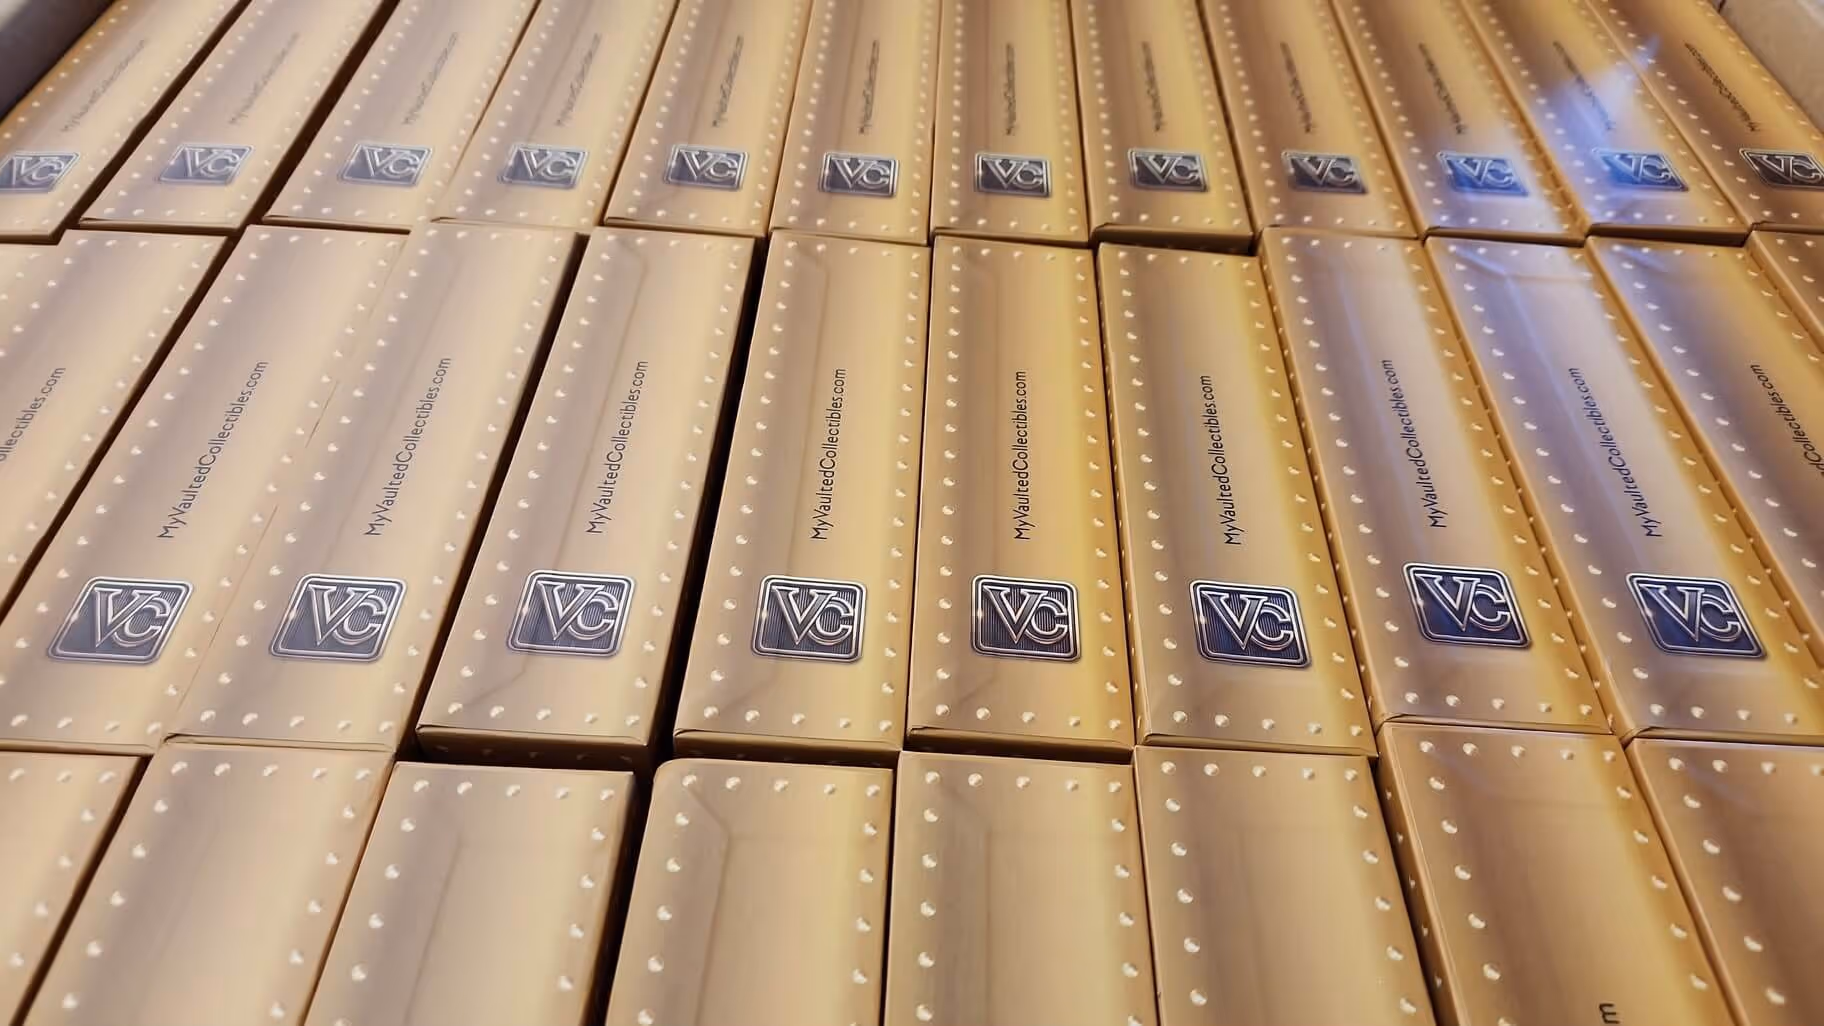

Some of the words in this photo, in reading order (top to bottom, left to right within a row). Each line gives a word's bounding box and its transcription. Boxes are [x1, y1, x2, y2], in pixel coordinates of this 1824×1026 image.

[157, 360, 269, 539] MyVaultedCollectibles.com
[365, 357, 451, 536] MyVaultedCollectibles.com
[586, 360, 648, 535] MyVaultedCollectibles.com
[810, 368, 847, 541] MyVaultedCollectibles.com
[1013, 371, 1034, 540] MyVaultedCollectibles.com
[1200, 375, 1242, 546] MyVaultedCollectibles.com
[1381, 359, 1447, 529] MyVaultedCollectibles.com
[1568, 367, 1663, 537] MyVaultedCollectibles.com
